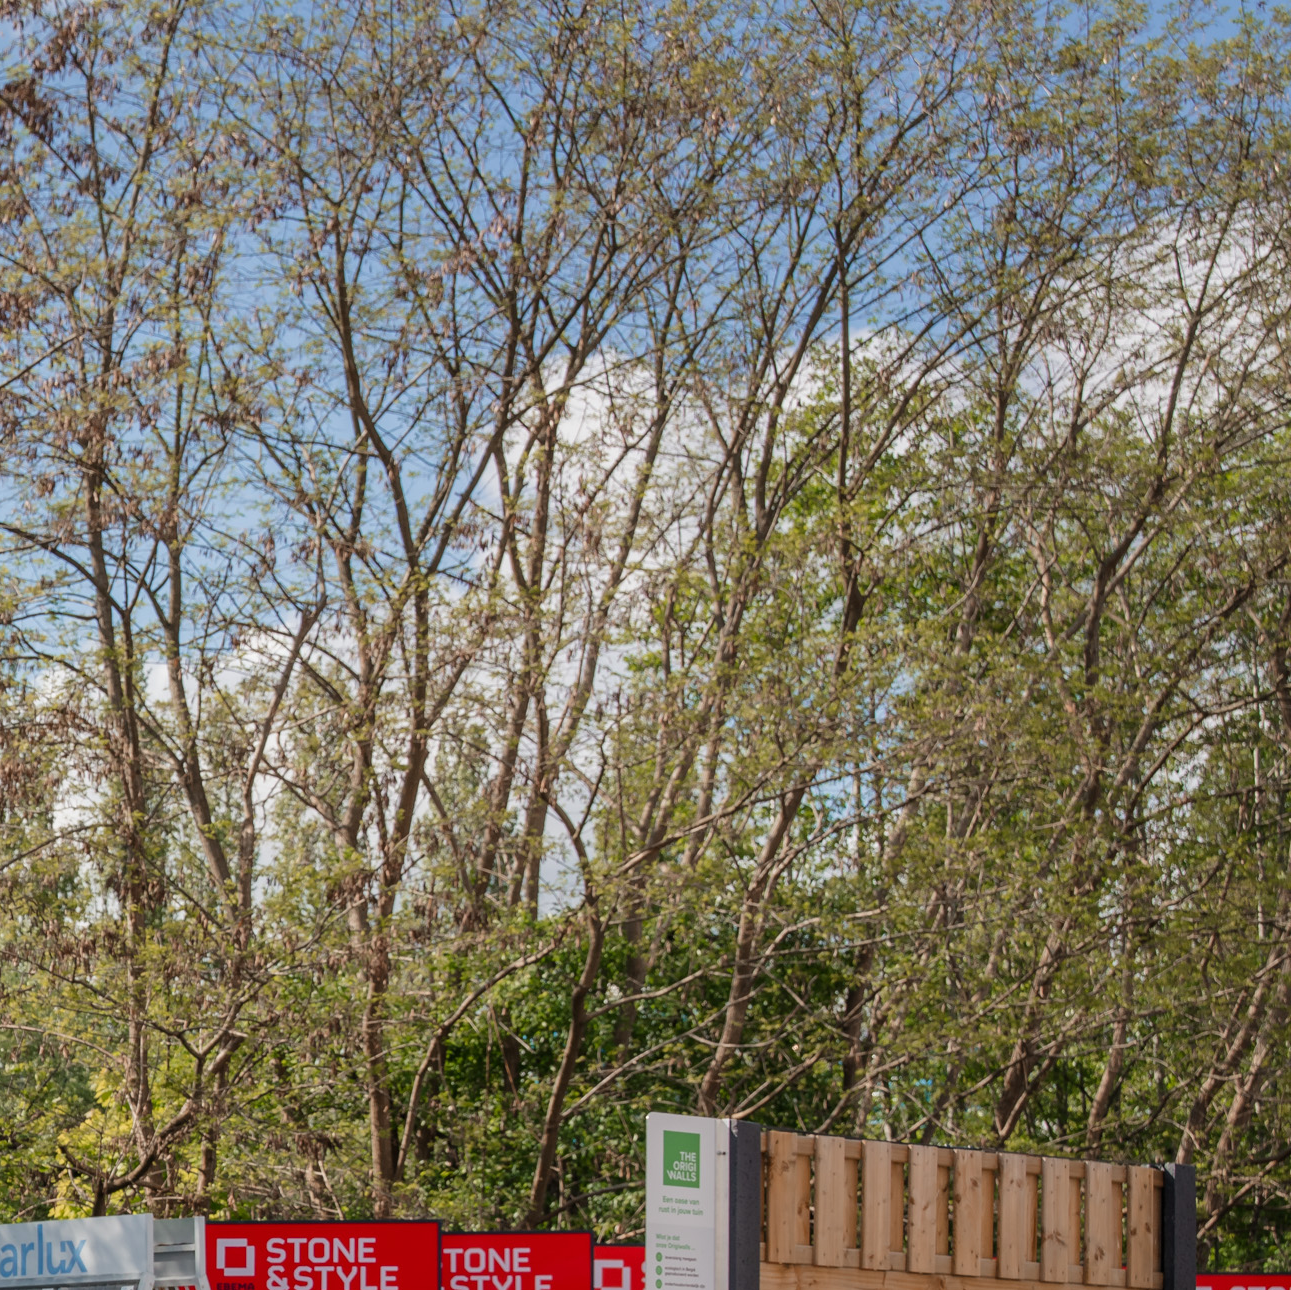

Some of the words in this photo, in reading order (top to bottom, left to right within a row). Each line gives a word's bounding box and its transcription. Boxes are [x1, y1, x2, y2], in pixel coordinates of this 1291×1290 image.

[679, 1151, 697, 1162] THE
[672, 1161, 697, 1172] ORIGI
[666, 1170, 697, 1182] WALLS
[266, 1237, 376, 1263] STONE
[441, 1247, 531, 1273] TONE
[216, 1282, 256, 1290] EBEMA
